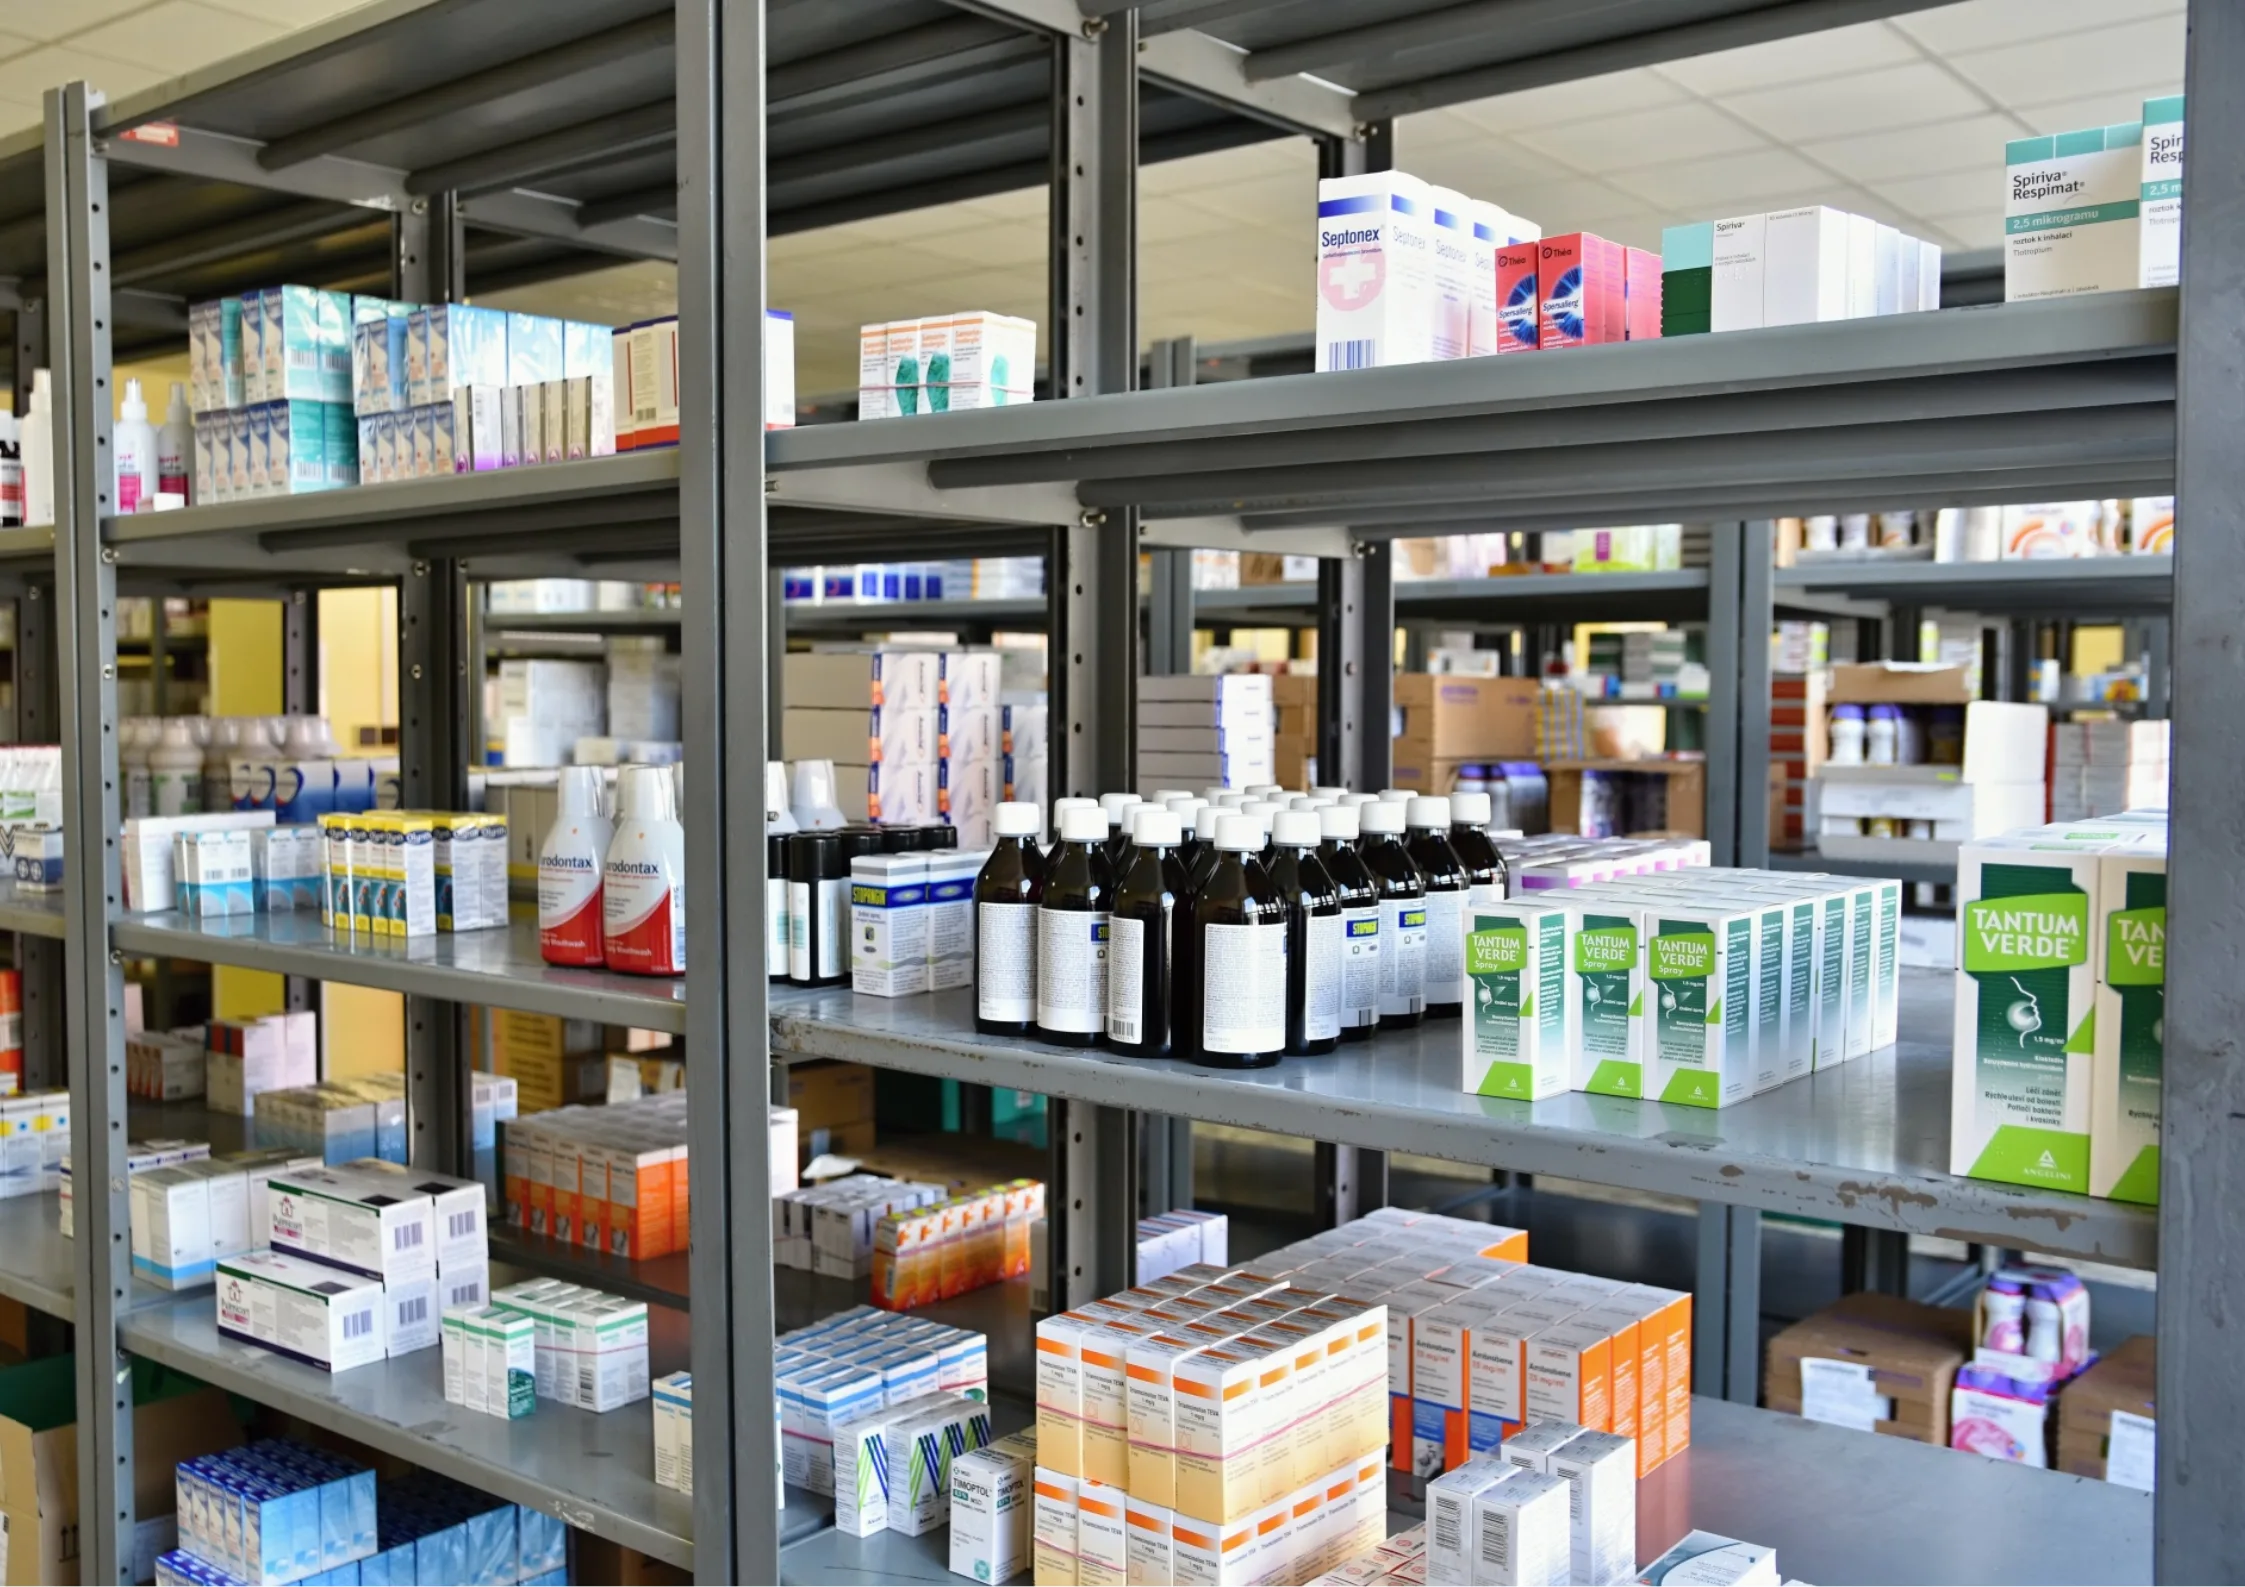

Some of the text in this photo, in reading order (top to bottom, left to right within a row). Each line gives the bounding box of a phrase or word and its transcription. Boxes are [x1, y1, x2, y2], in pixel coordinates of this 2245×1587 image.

[2032, 210, 2099, 225] mikrogramu
[1322, 228, 1380, 248] Septonex
[2013, 236, 2035, 245] roztok
[1973, 908, 2080, 936] TANTUM
[1473, 935, 1520, 950] TANTUM
[1582, 934, 1629, 950] TANTUM
[1656, 939, 1707, 955] TANTUM
[1980, 932, 2070, 959] VERDE
[1476, 947, 1517, 962] VERDE
[1585, 946, 1626, 962] VERDE
[1660, 952, 1703, 967] VERDE
[1475, 960, 1498, 972] Spray
[1584, 959, 1607, 971] Spray
[1658, 965, 1684, 976] Spray
[2023, 1167, 2071, 1180] ANGELINI
[953, 1478, 990, 1497] TIMOPTOL
